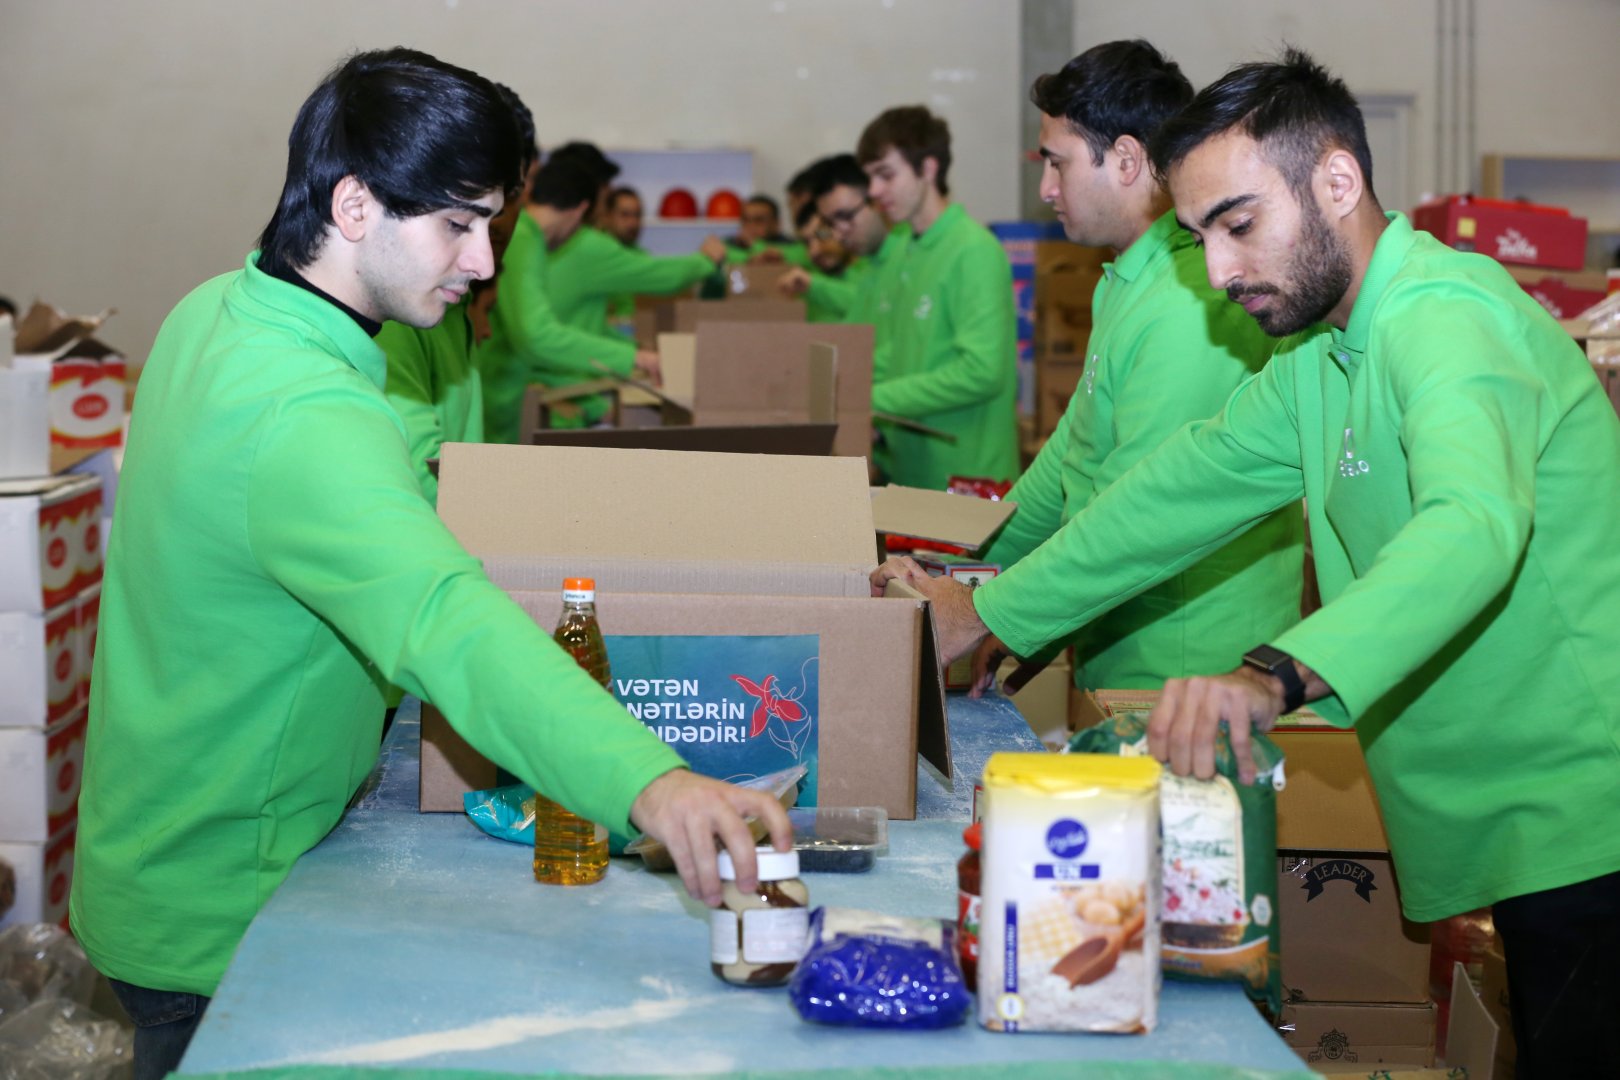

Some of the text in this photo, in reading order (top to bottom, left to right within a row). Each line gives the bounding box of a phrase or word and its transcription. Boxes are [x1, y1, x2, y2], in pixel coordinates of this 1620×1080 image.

[617, 679, 698, 697] VƏTƏN
[626, 698, 745, 720] NƏTLƏRİN
[642, 721, 746, 743] NDƏDİR!
[1313, 863, 1367, 883] LEADER
